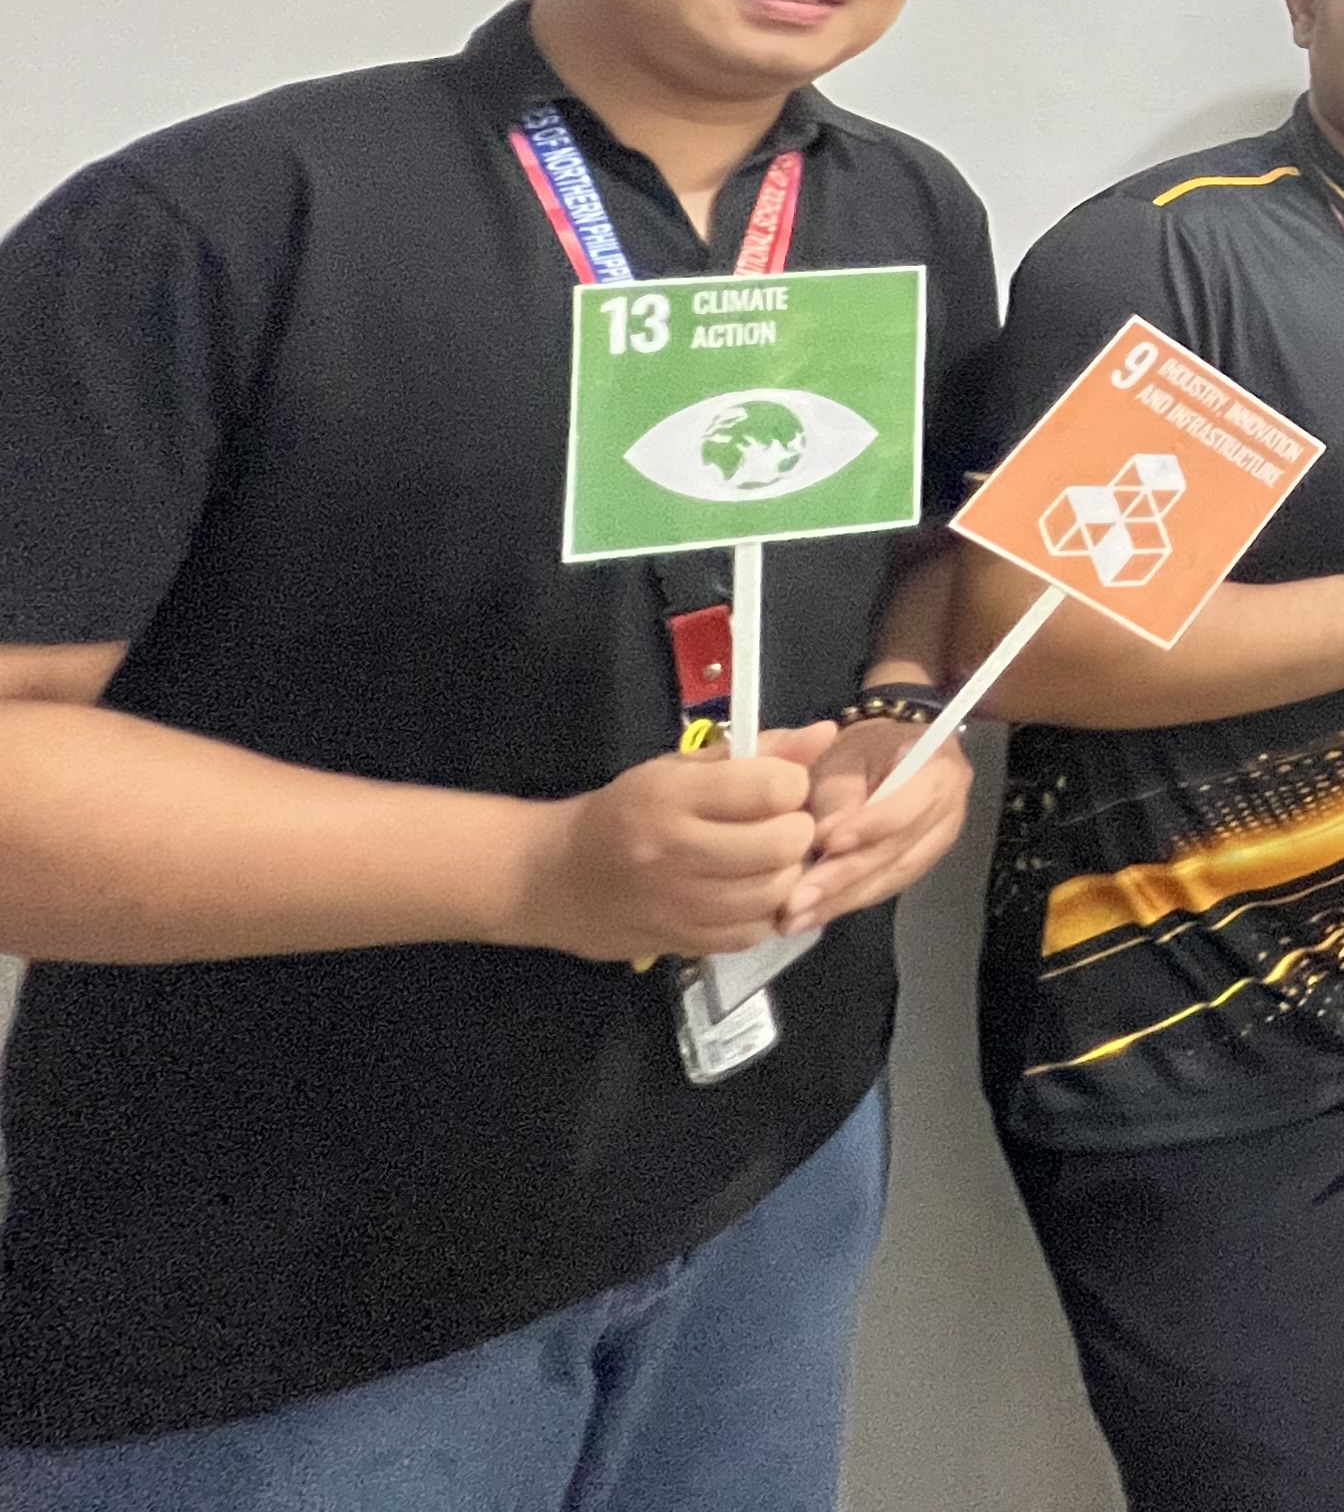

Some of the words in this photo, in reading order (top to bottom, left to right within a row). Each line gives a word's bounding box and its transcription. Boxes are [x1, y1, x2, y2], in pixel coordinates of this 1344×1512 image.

[532, 126, 571, 147] OF
[543, 145, 609, 226] NORTHERN
[599, 294, 671, 355] 13
[692, 286, 788, 316] CLIMATE
[690, 321, 777, 349] ACTION
[1110, 341, 1158, 390] 9
[1135, 385, 1169, 414] AND
[1166, 402, 1286, 489] INFRASTRUCTURE
[1157, 357, 1226, 419] INDUSTRY,
[1223, 401, 1305, 464] INNOVATION
